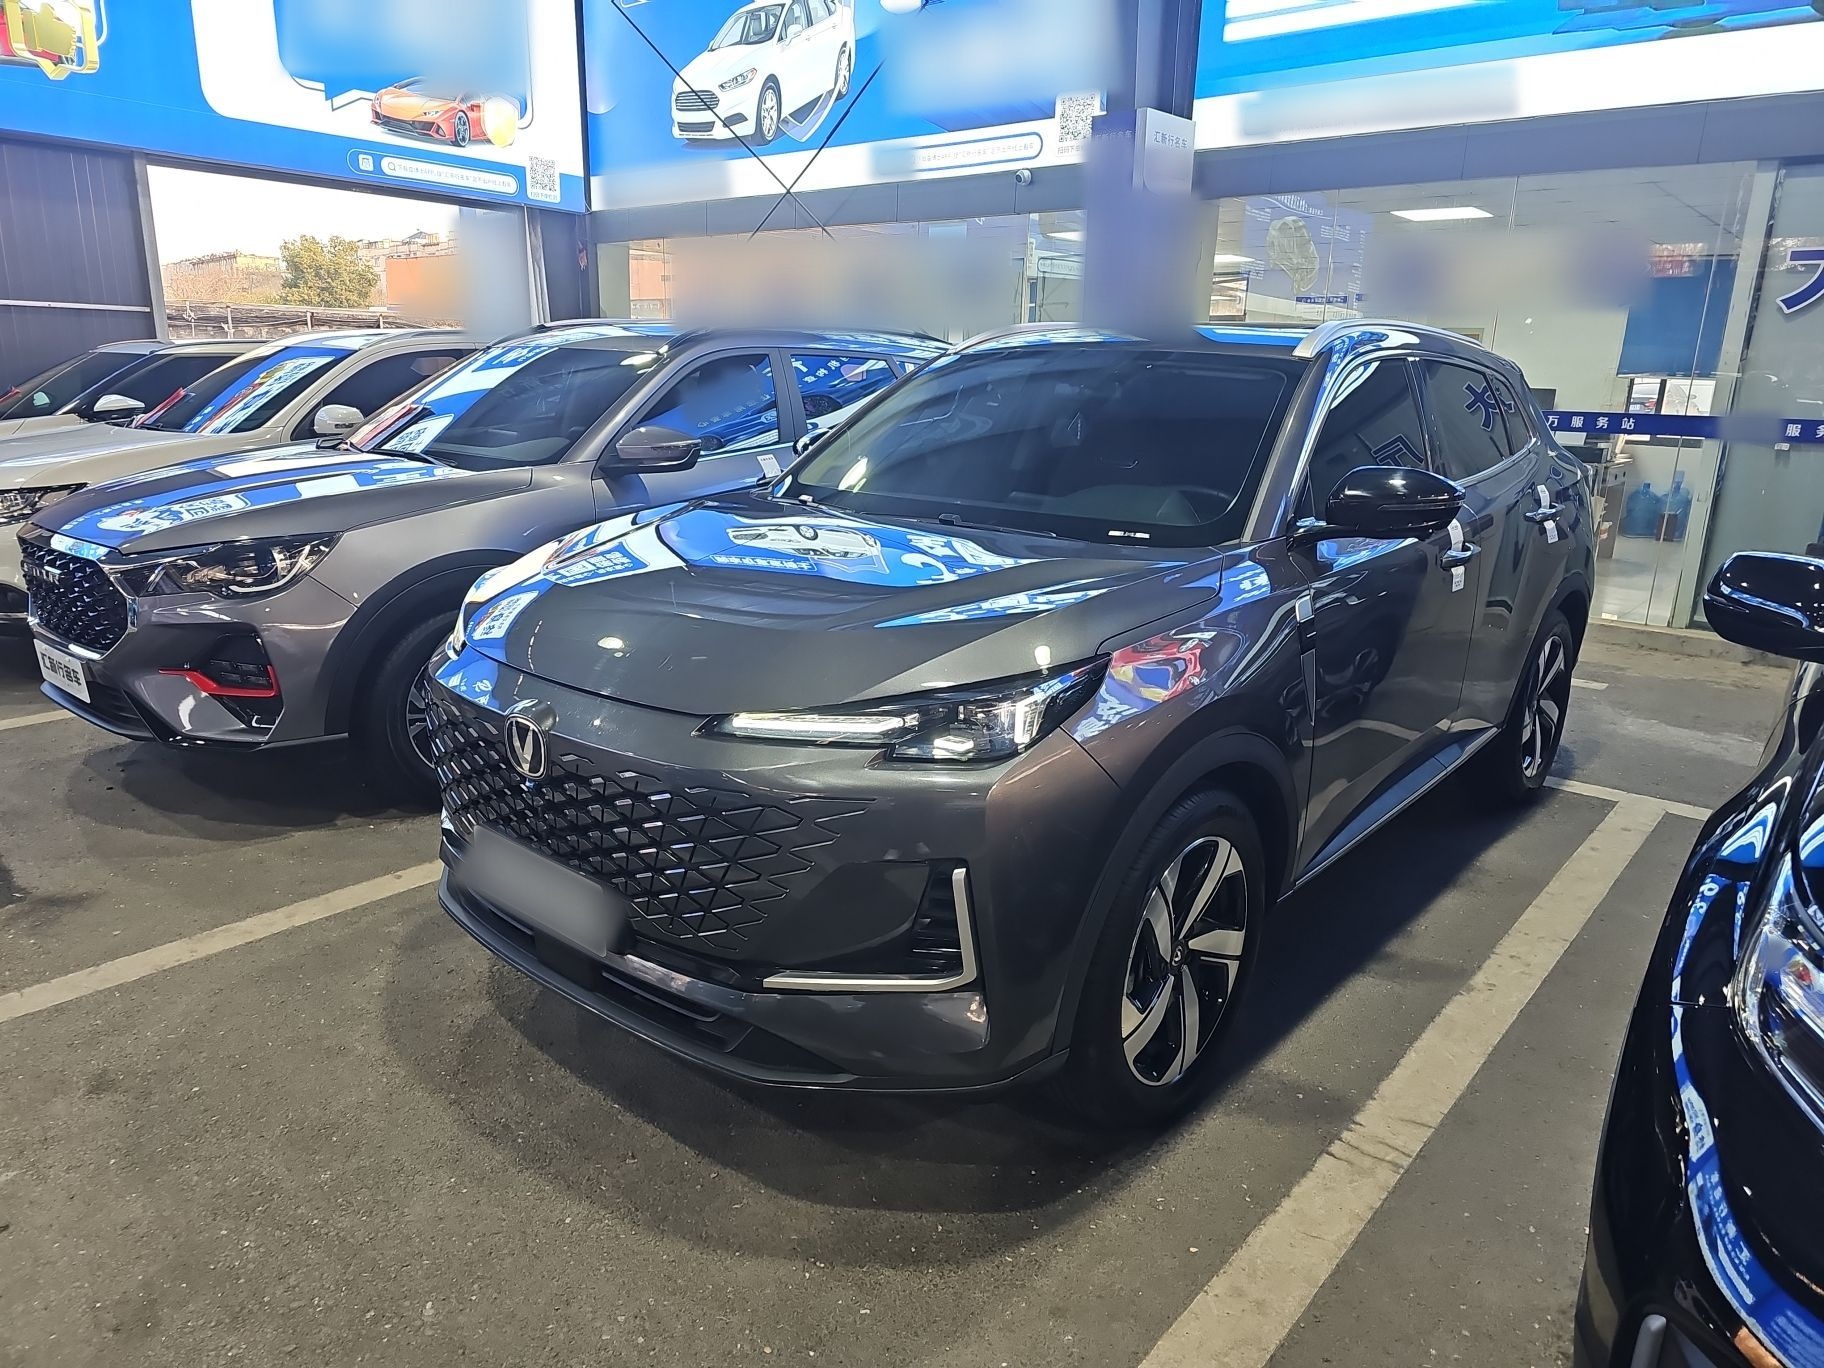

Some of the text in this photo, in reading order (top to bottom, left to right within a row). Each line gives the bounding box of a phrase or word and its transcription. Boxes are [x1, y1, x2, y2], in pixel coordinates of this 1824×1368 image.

[1153, 131, 1188, 149] 汇新行名车
[1547, 415, 1636, 430] 万服务站
